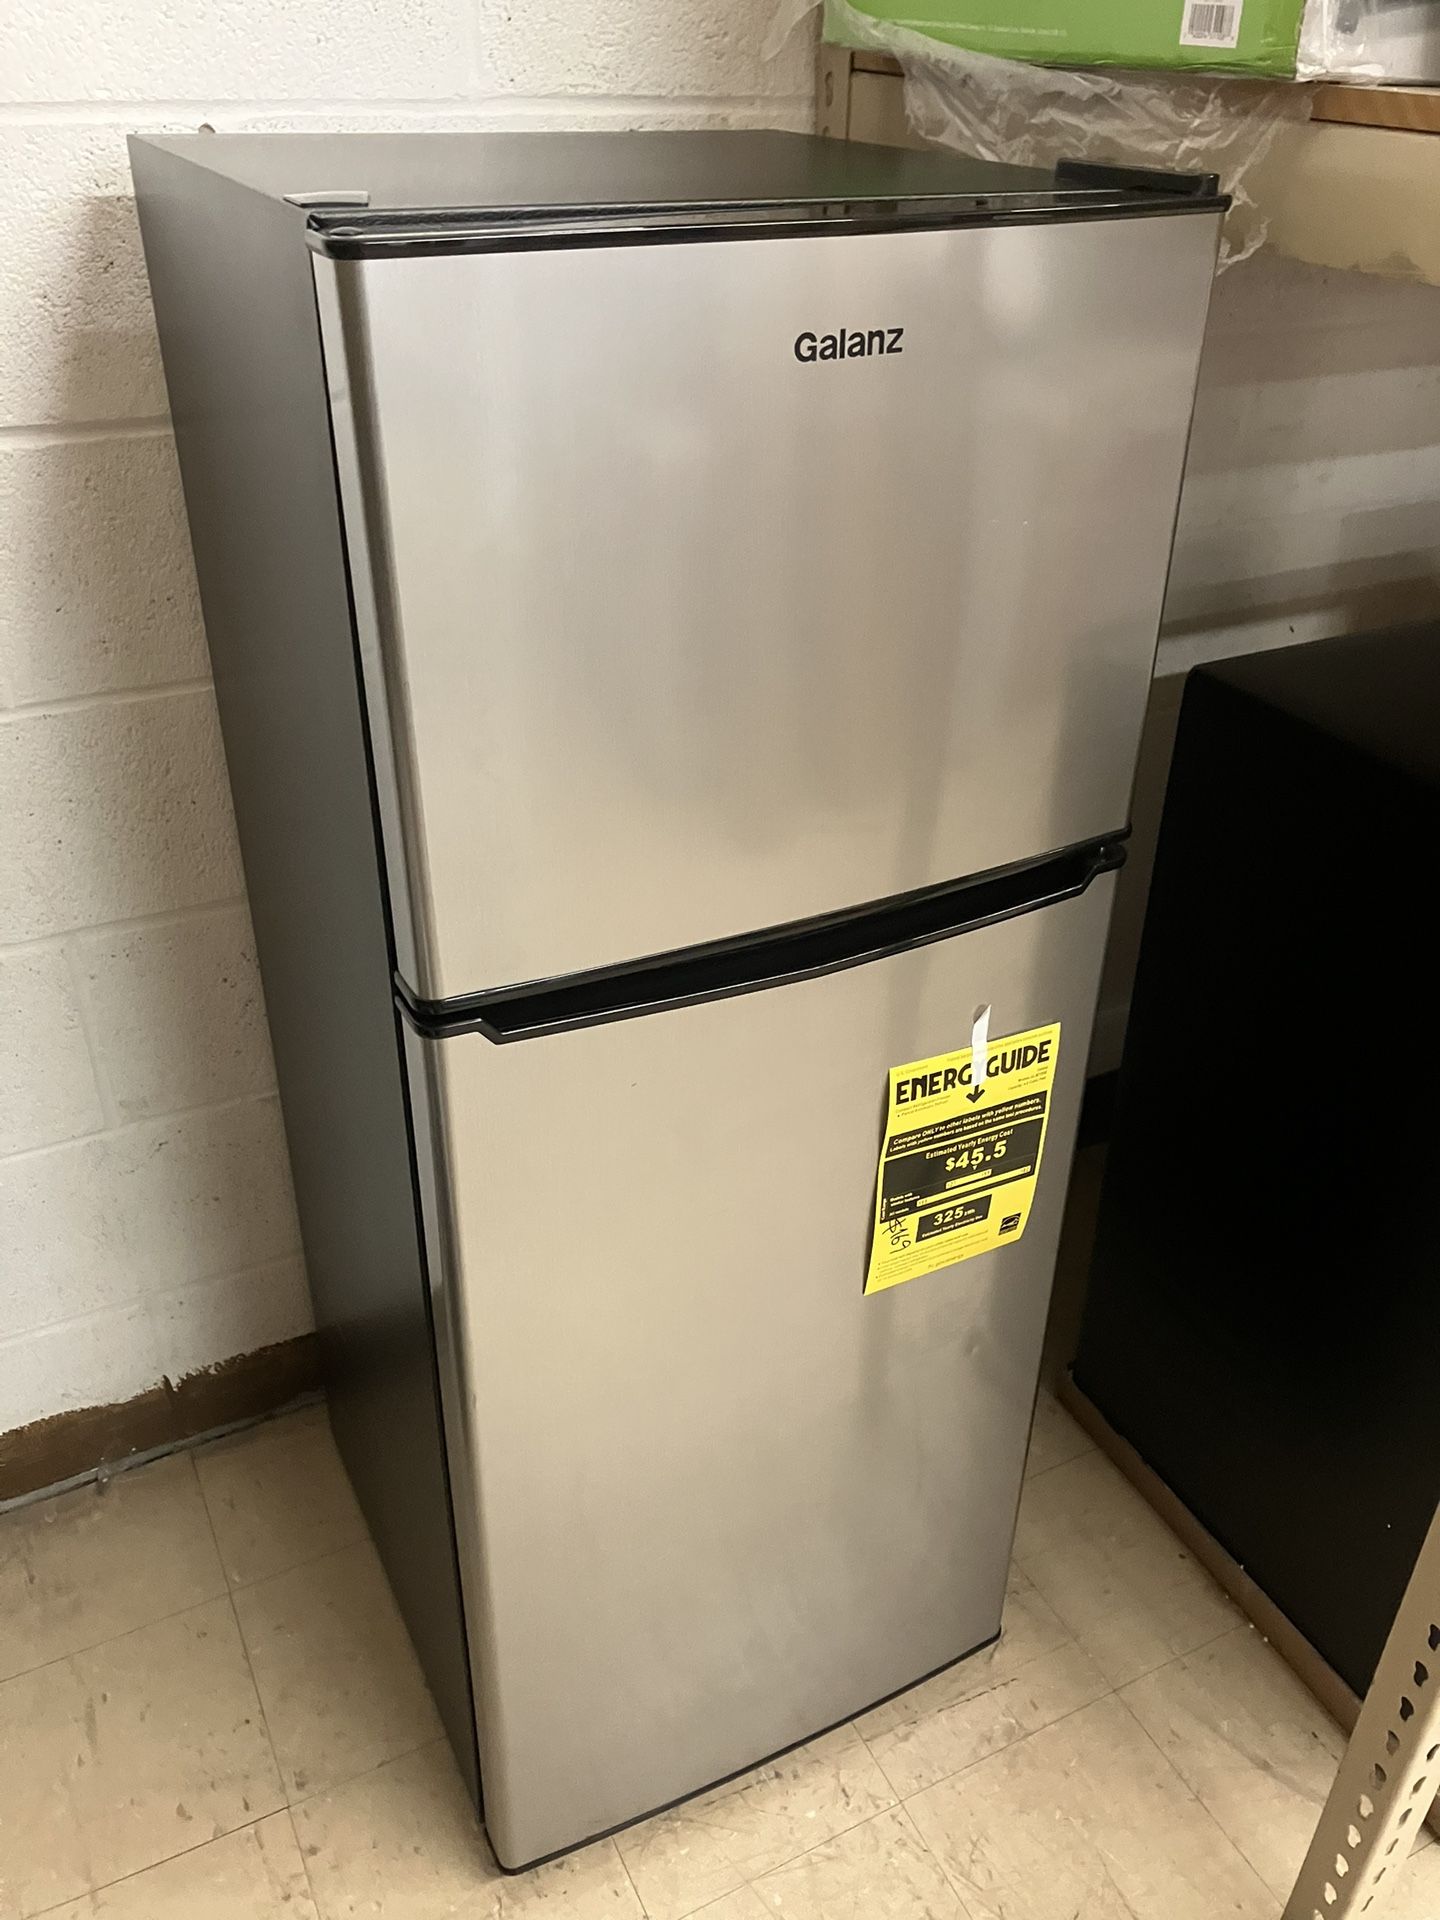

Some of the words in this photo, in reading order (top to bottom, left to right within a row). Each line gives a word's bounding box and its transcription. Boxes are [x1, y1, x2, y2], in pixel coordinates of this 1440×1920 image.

[795, 328, 904, 363] Galanz
[893, 1132, 921, 1146] Compare
[922, 1126, 939, 1137] ONLY
[925, 1145, 957, 1159] Estimated
[957, 1139, 977, 1151] Yearly
[977, 1133, 998, 1145] Energy
[998, 1128, 1014, 1138] Cost
[945, 1139, 1007, 1172] $45.5
[933, 1206, 964, 1226] 325
